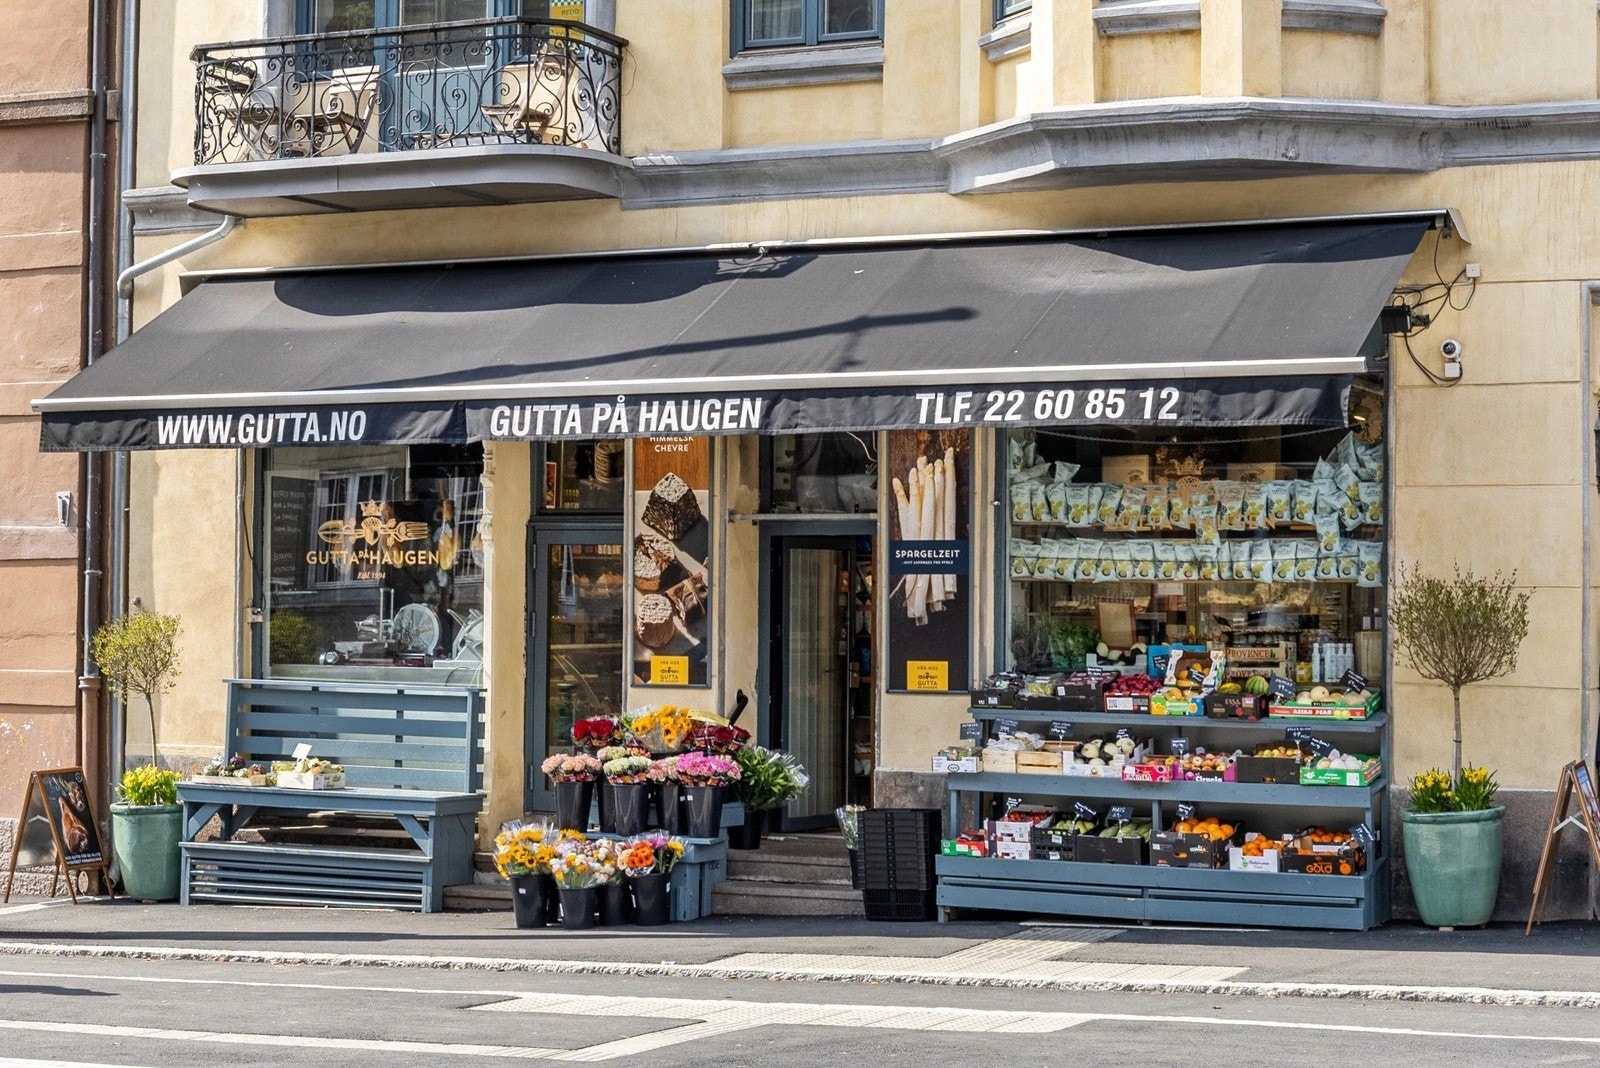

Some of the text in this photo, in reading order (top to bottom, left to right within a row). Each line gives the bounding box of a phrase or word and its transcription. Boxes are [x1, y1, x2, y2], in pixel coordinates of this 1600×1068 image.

[915, 386, 1181, 424] TLF. 22 60 85 12
[490, 395, 763, 436] GUTTA PÅ HAUGEN
[157, 410, 366, 445] WWW.GUTTA.NO
[654, 444, 689, 453] CHEVRE
[306, 550, 360, 565] GUTTA
[369, 550, 439, 565] HAUGEN
[895, 549, 960, 558] SPARGELZEIT
[1225, 648, 1270, 658] PROVENCE
